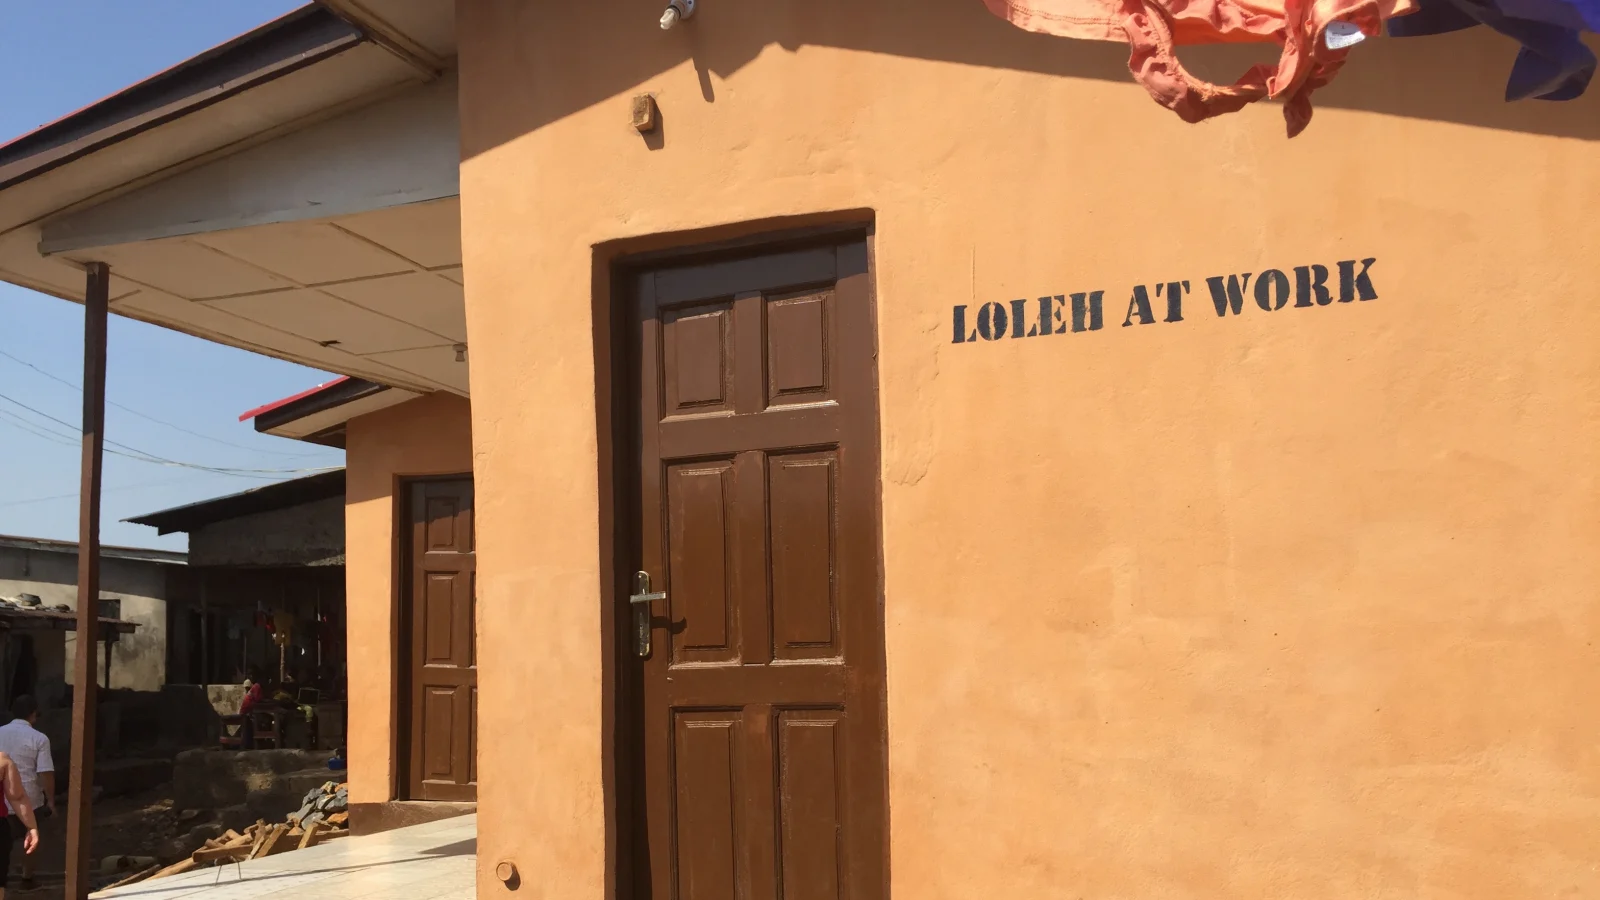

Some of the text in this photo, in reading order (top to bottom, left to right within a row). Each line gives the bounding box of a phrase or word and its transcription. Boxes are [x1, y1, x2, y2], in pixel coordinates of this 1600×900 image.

[951, 257, 1379, 344] LOLEH AT WORK
